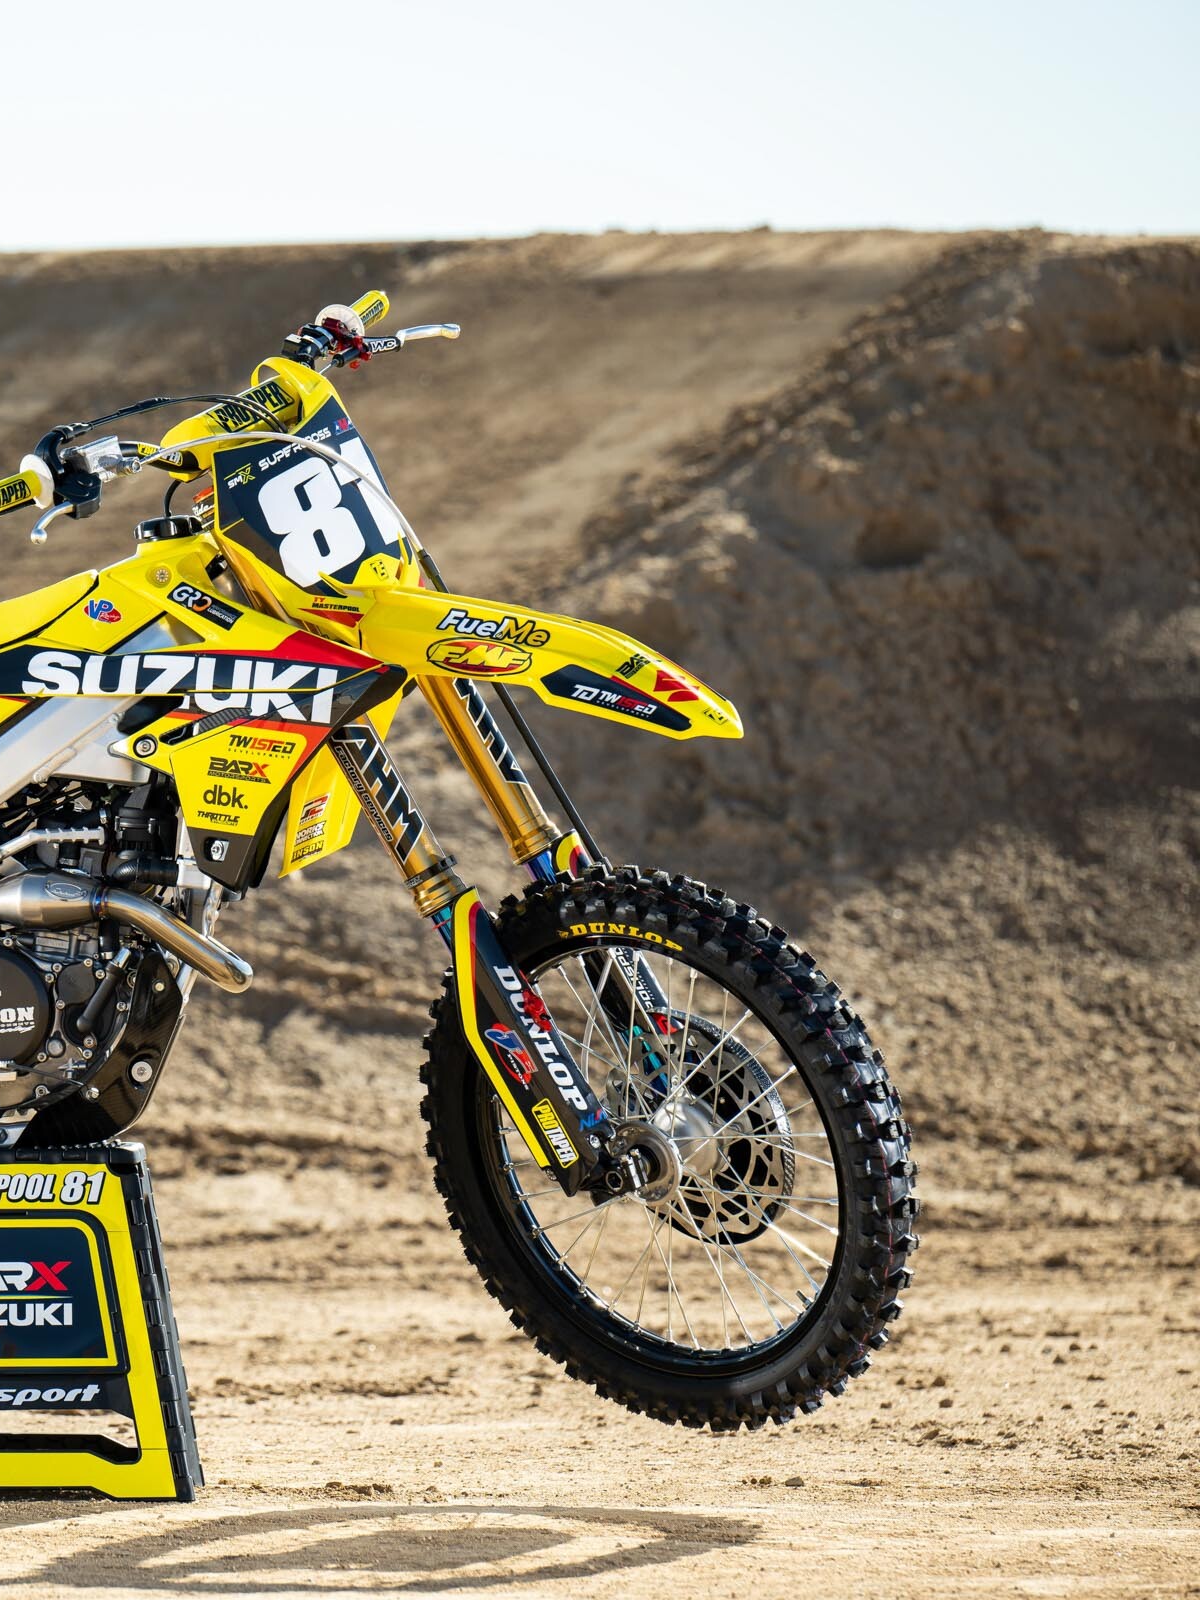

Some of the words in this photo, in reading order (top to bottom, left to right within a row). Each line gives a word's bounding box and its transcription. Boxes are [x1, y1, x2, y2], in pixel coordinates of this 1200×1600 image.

[258, 437, 407, 588] 81
[88, 599, 113, 620] VP
[311, 603, 360, 612] MASTERPOOL
[436, 608, 550, 647] FuelMe
[427, 641, 533, 672] FMF
[22, 652, 338, 723] SUZUKI
[209, 757, 270, 777] BARX
[332, 725, 425, 865] AHM
[197, 810, 240, 823] THROTTLE
[570, 922, 683, 951] DUNLOP
[56, 1170, 108, 1206] 81
